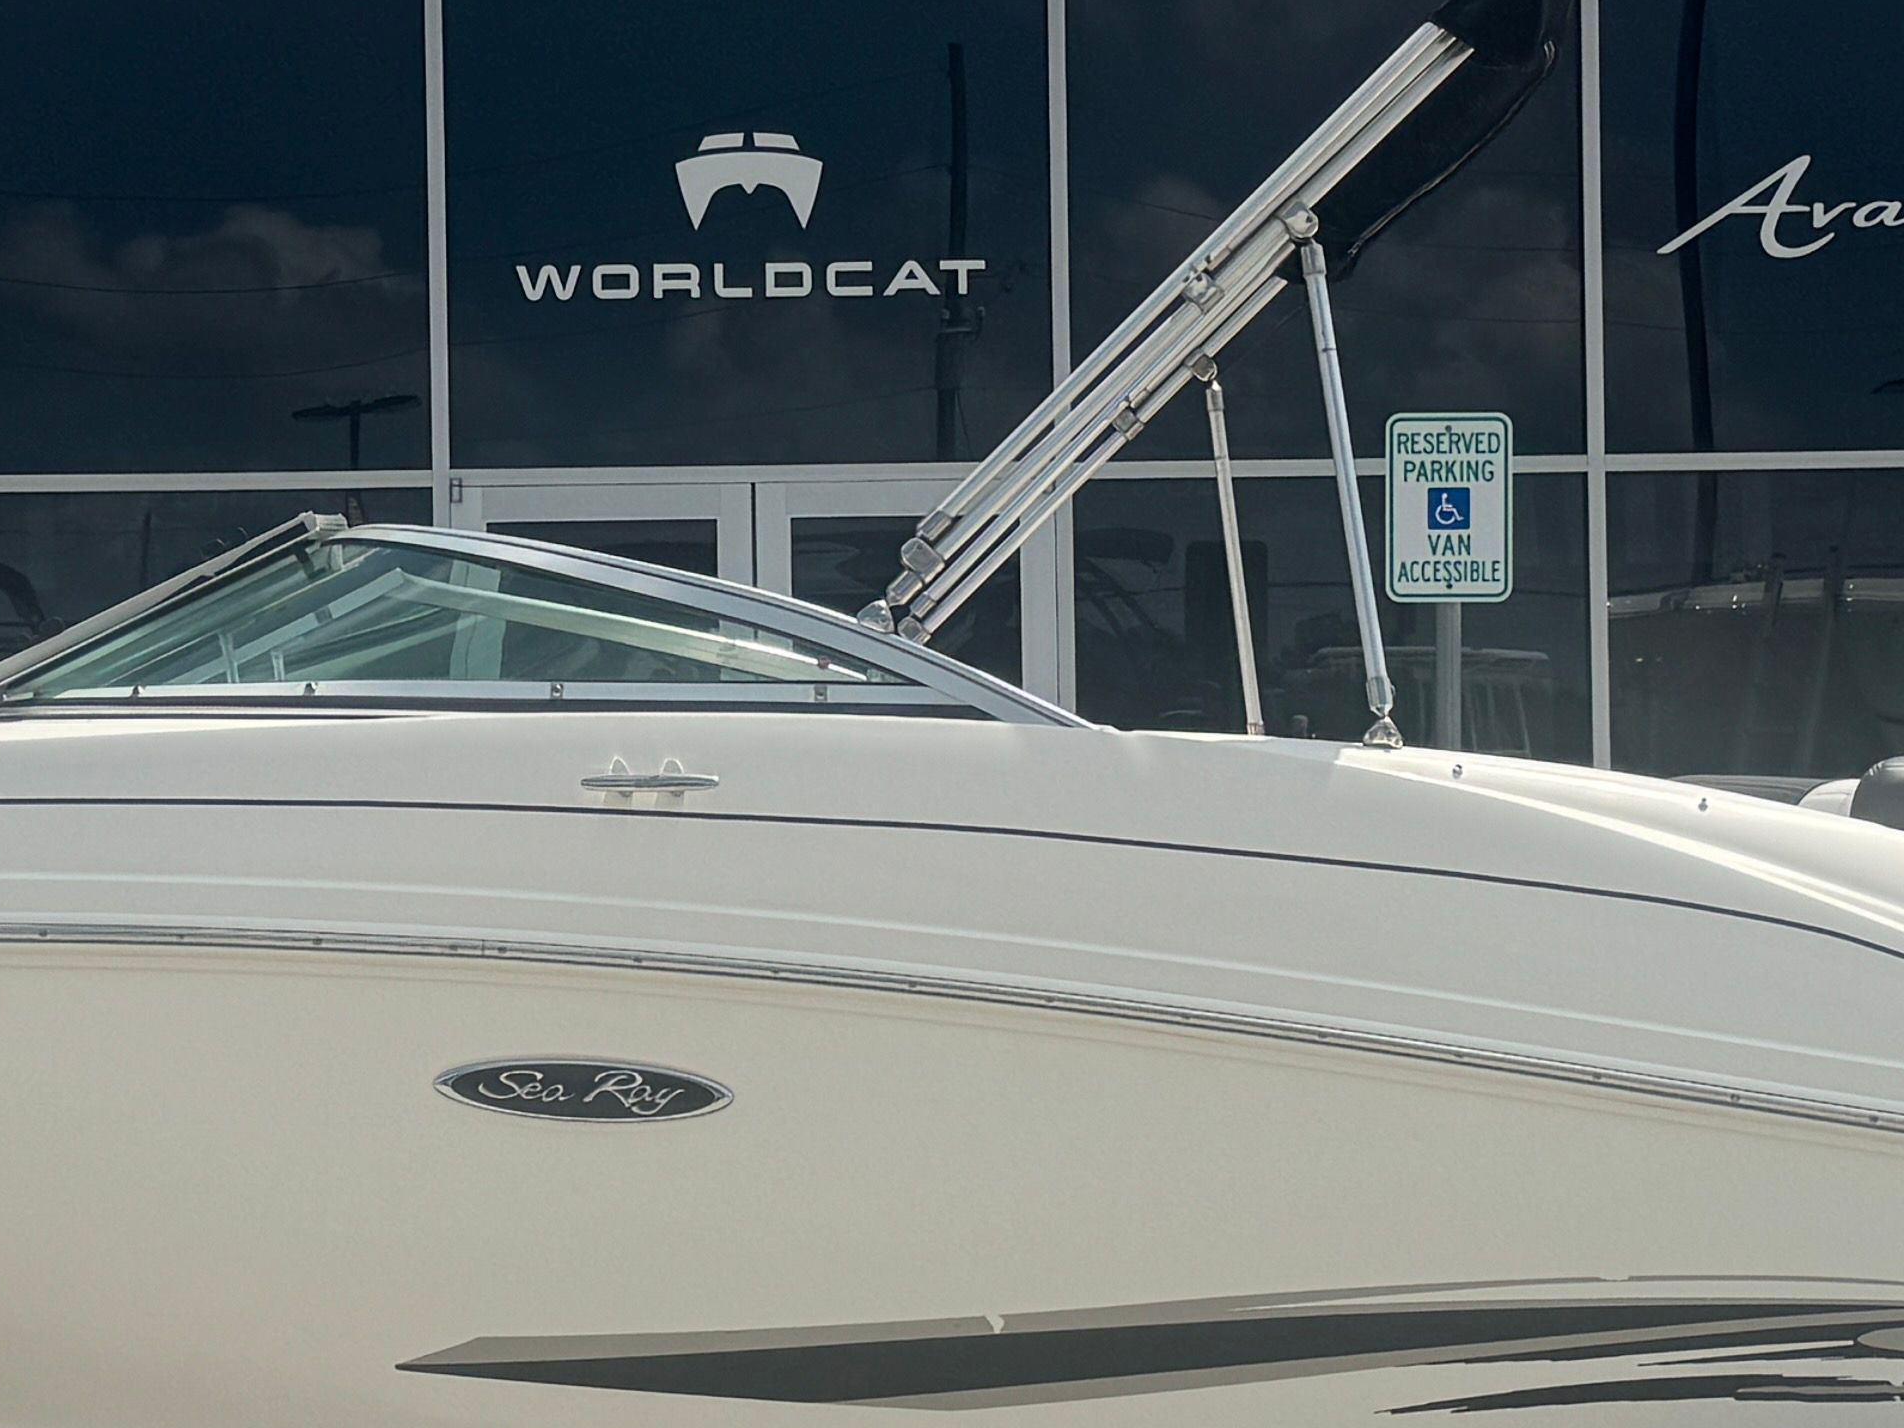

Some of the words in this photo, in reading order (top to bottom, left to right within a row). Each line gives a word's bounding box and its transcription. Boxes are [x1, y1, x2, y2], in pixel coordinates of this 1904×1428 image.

[515, 259, 986, 301] WORLDCAT
[1397, 432, 1501, 455] RESERVED
[1403, 459, 1495, 483] PARKING
[1427, 533, 1472, 557] VAN
[1397, 560, 1501, 583] ACCESSIBLE
[478, 1070, 575, 1103] Sea
[583, 1070, 686, 1116] Ray
